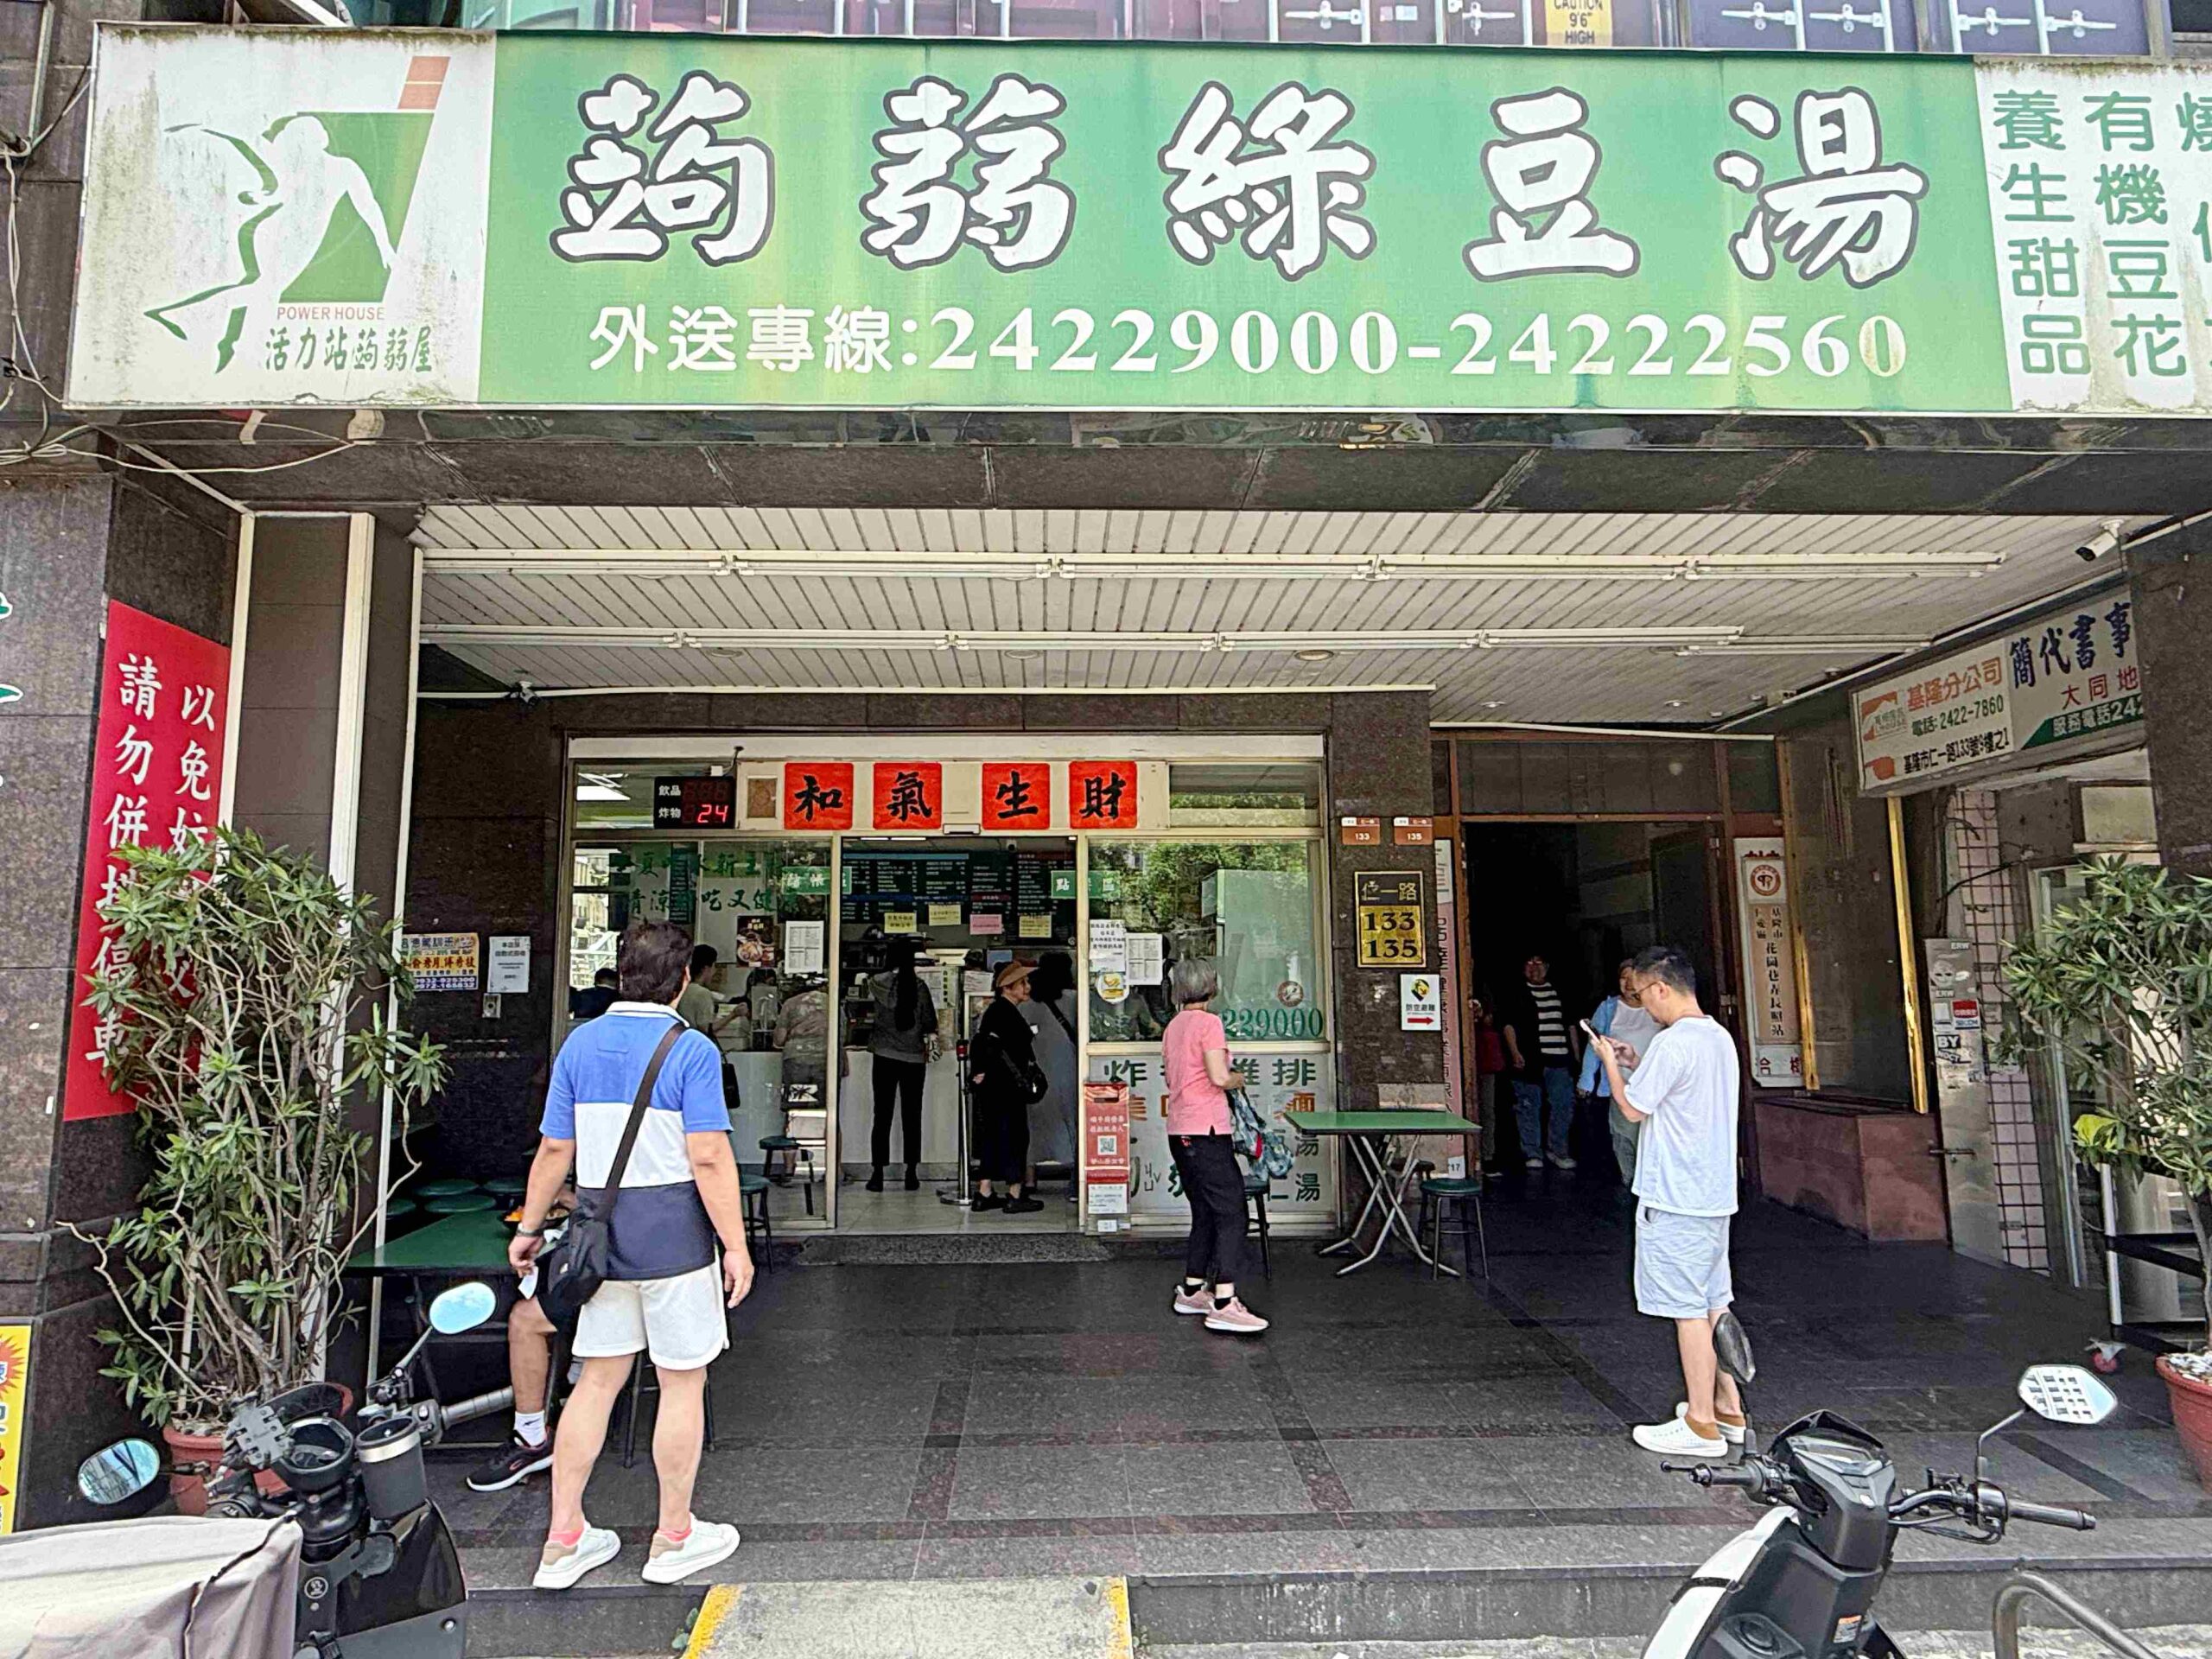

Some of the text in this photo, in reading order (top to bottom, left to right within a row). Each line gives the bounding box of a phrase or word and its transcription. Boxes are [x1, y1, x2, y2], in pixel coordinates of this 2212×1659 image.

[1554, 0, 1603, 10] CAUTION
[1565, 31, 1595, 44] HIGH
[550, 70, 1929, 288] 蒟蒻綠豆湯
[1993, 89, 2091, 374] 養生甜品
[2082, 91, 2187, 377] 有機豆花
[276, 307, 385, 320] POWER HOUSE
[266, 326, 431, 372] 活力站蒟蒻屋
[1907, 657, 2002, 712] 基隆分公司
[658, 785, 681, 796] 飲品
[794, 772, 1127, 822] 和氣生財
[658, 804, 729, 823] 炸物 24
[1362, 880, 1417, 900] 仁一路
[1363, 912, 1415, 931] 133
[1366, 939, 1418, 958] 135
[1938, 1036, 1959, 1048] BY
